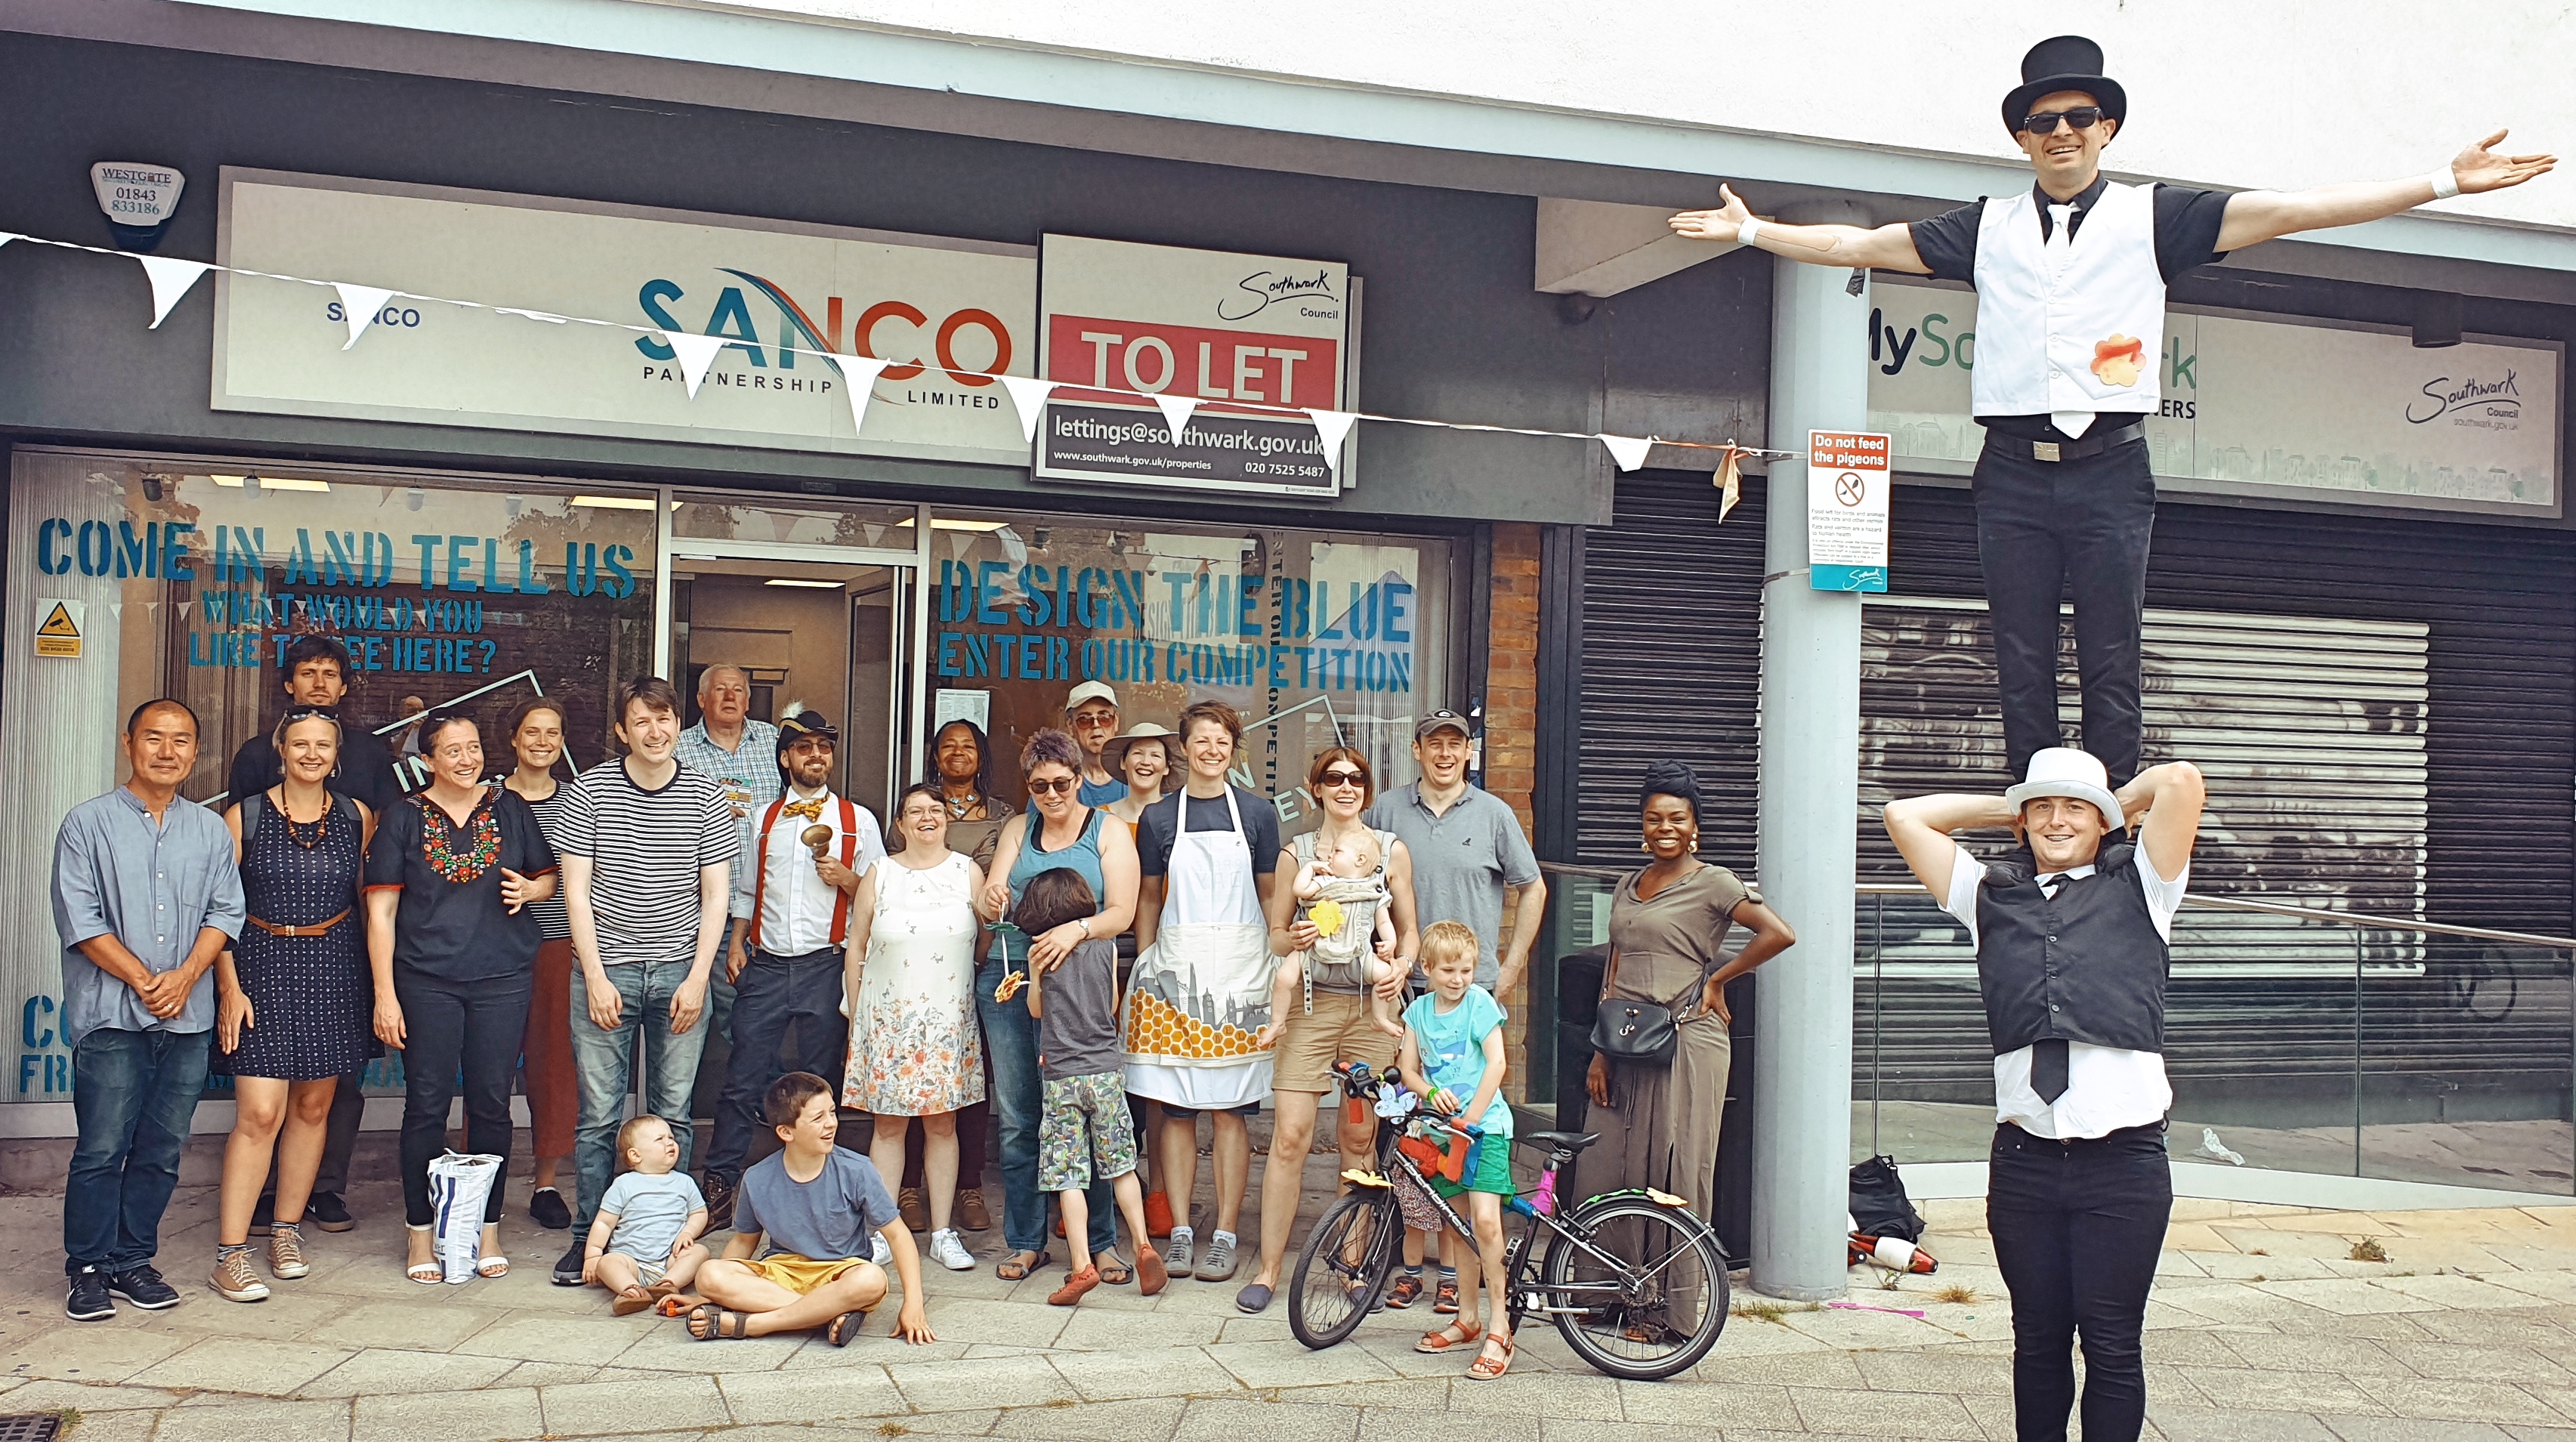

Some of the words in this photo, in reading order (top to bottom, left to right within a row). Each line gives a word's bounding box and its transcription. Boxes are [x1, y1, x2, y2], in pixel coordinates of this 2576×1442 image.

[112, 200, 159, 215] 833186
[116, 187, 156, 201] 01843
[1217, 270, 1331, 320] Southwark
[326, 302, 421, 328] SCO
[1300, 307, 1339, 320] Council
[635, 272, 1012, 388] SANCO
[644, 366, 832, 394] PANERSHIP
[1081, 331, 1175, 394] TO
[1197, 341, 1308, 403] LET
[908, 390, 999, 409] LIMITED
[2406, 369, 2519, 424] Southwark
[2487, 407, 2519, 418] Council
[1055, 415, 1324, 457] lettings@sothwark.gov.uk
[1815, 434, 1833, 447] Do
[1836, 437, 1855, 449] not
[1858, 437, 1884, 450] feed
[1054, 452, 1212, 470] www.southwark.gov.uk/properties
[1245, 462, 1266, 474] 020
[1268, 463, 1296, 477] 7525
[1298, 465, 1325, 478] 5487
[1815, 450, 1833, 462] the
[1836, 451, 1885, 467] pigeons
[39, 517, 196, 582] COME
[215, 524, 264, 583] IN
[284, 528, 394, 588] AND
[412, 534, 550, 595] TELL
[567, 542, 635, 599] US
[201, 589, 295, 628] WHAT
[305, 593, 414, 631] WOULD
[423, 597, 483, 634] YOU
[939, 559, 1143, 630] DESIGN
[1162, 572, 1265, 637] THE
[1280, 576, 1412, 643] BLUE
[189, 631, 261, 669] LIKE
[272, 635, 305, 669] T
[326, 635, 383, 671] EE
[393, 637, 497, 674] HERE?
[938, 632, 1070, 681] ENTER
[1080, 638, 1156, 684] OUR
[1166, 642, 1410, 693] COMPETITION
